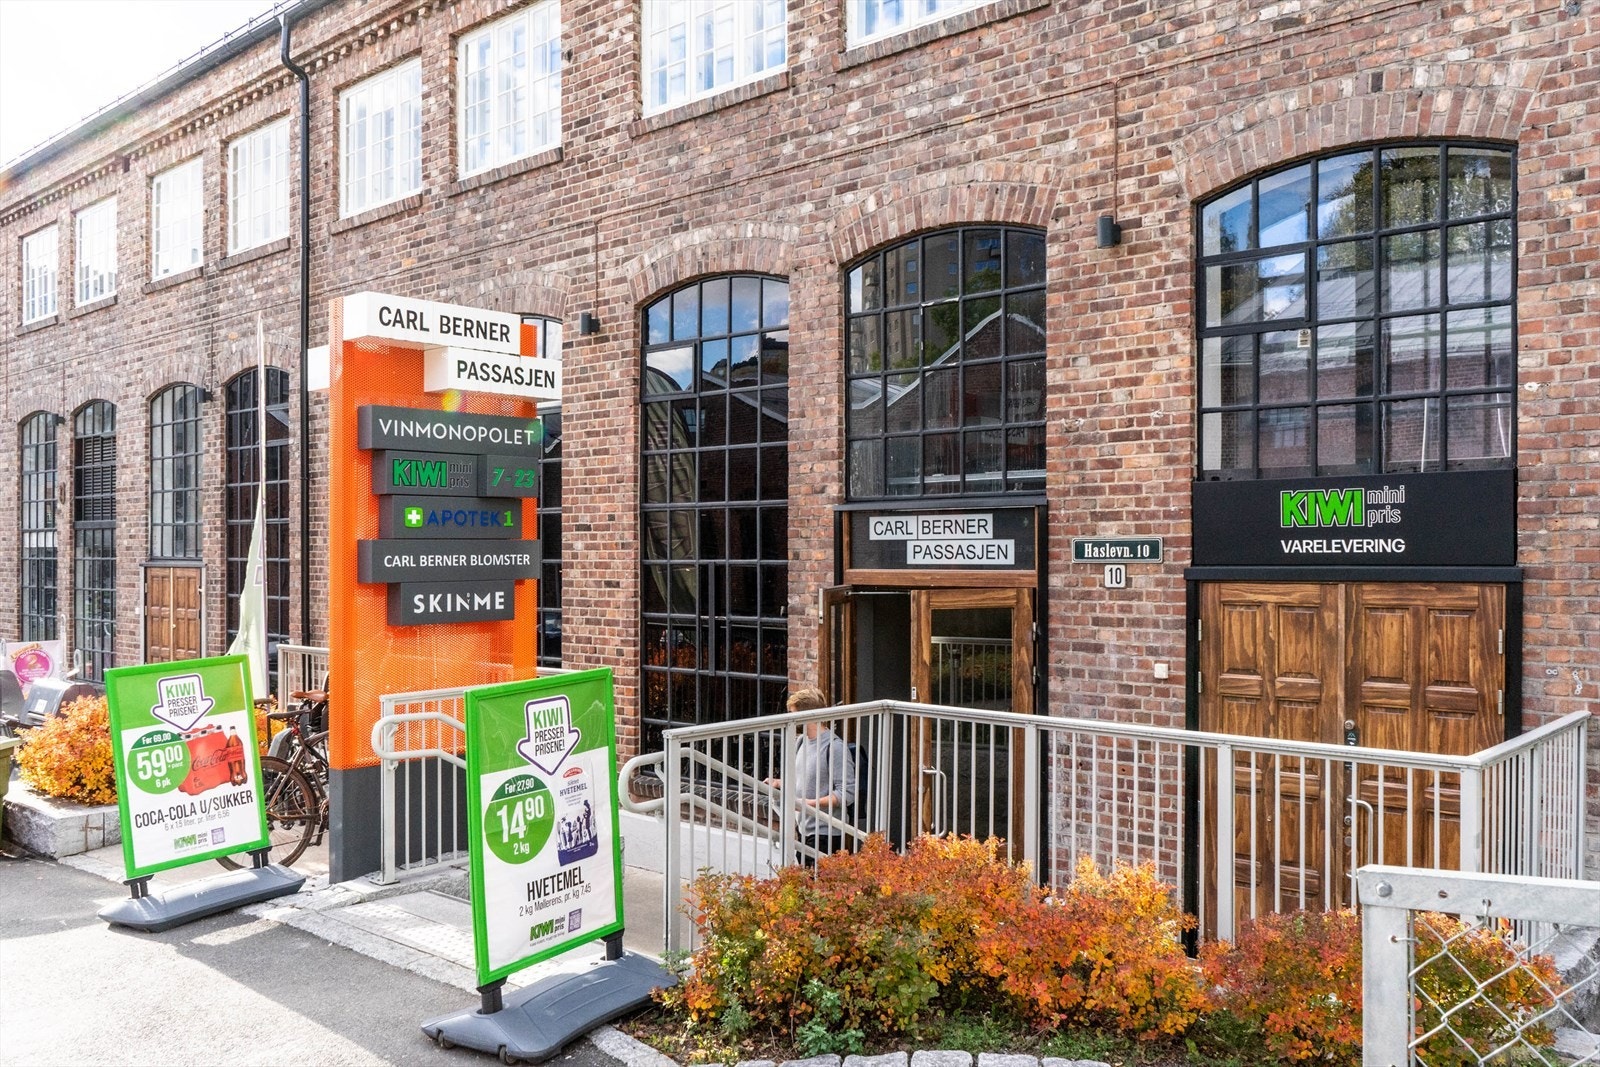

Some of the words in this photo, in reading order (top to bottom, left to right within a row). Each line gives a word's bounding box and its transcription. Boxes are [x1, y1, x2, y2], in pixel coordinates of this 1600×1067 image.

[379, 306, 430, 332] CARL
[439, 315, 511, 343] BERNER
[457, 359, 555, 389] PASSASJEN
[378, 418, 534, 445] VINMONOPOLET
[392, 458, 450, 490] KIWI
[449, 462, 473, 475] mini
[449, 476, 470, 490] pris
[491, 467, 505, 487] 7
[514, 469, 536, 488] 23
[1280, 488, 1365, 528] KIWI
[1367, 485, 1406, 505] mini
[426, 509, 502, 527] APOTEK
[1367, 505, 1402, 527] pris
[873, 520, 914, 536] CARL
[921, 518, 989, 535] BERNER
[912, 544, 1009, 560] PASSASJEN
[1084, 542, 1134, 558] Haslevn.
[1136, 542, 1150, 558] 10
[1280, 538, 1406, 553] VARELEVERING
[384, 555, 417, 568] CARL
[419, 554, 467, 567] BERNER
[470, 554, 531, 566] BLOMSTER
[1108, 567, 1123, 585] 10
[165, 682, 196, 698] KIWI
[167, 696, 198, 707] PRESSER
[169, 705, 200, 718] PRISENE!
[533, 707, 564, 730] KIWI
[534, 726, 565, 744] PRESSER
[535, 739, 566, 757] PRISENE!
[155, 778, 161, 788] 6
[162, 778, 172, 788] pk
[505, 782, 517, 795] Før
[517, 778, 535, 793] 27,90
[560, 783, 588, 797] HVETEMEL
[134, 802, 197, 829] COCA-COLA
[199, 790, 254, 815] U/SUKKER
[173, 834, 197, 850] KIWI
[197, 837, 208, 845] pris
[513, 843, 519, 856] 2
[520, 842, 530, 855] kg
[527, 866, 585, 902] HVETEMEL
[519, 905, 524, 917] 2
[525, 905, 534, 916] kg
[572, 889, 580, 900] kg
[529, 919, 555, 942] KIWI
[555, 915, 566, 925] mini
[554, 923, 565, 933] pris
